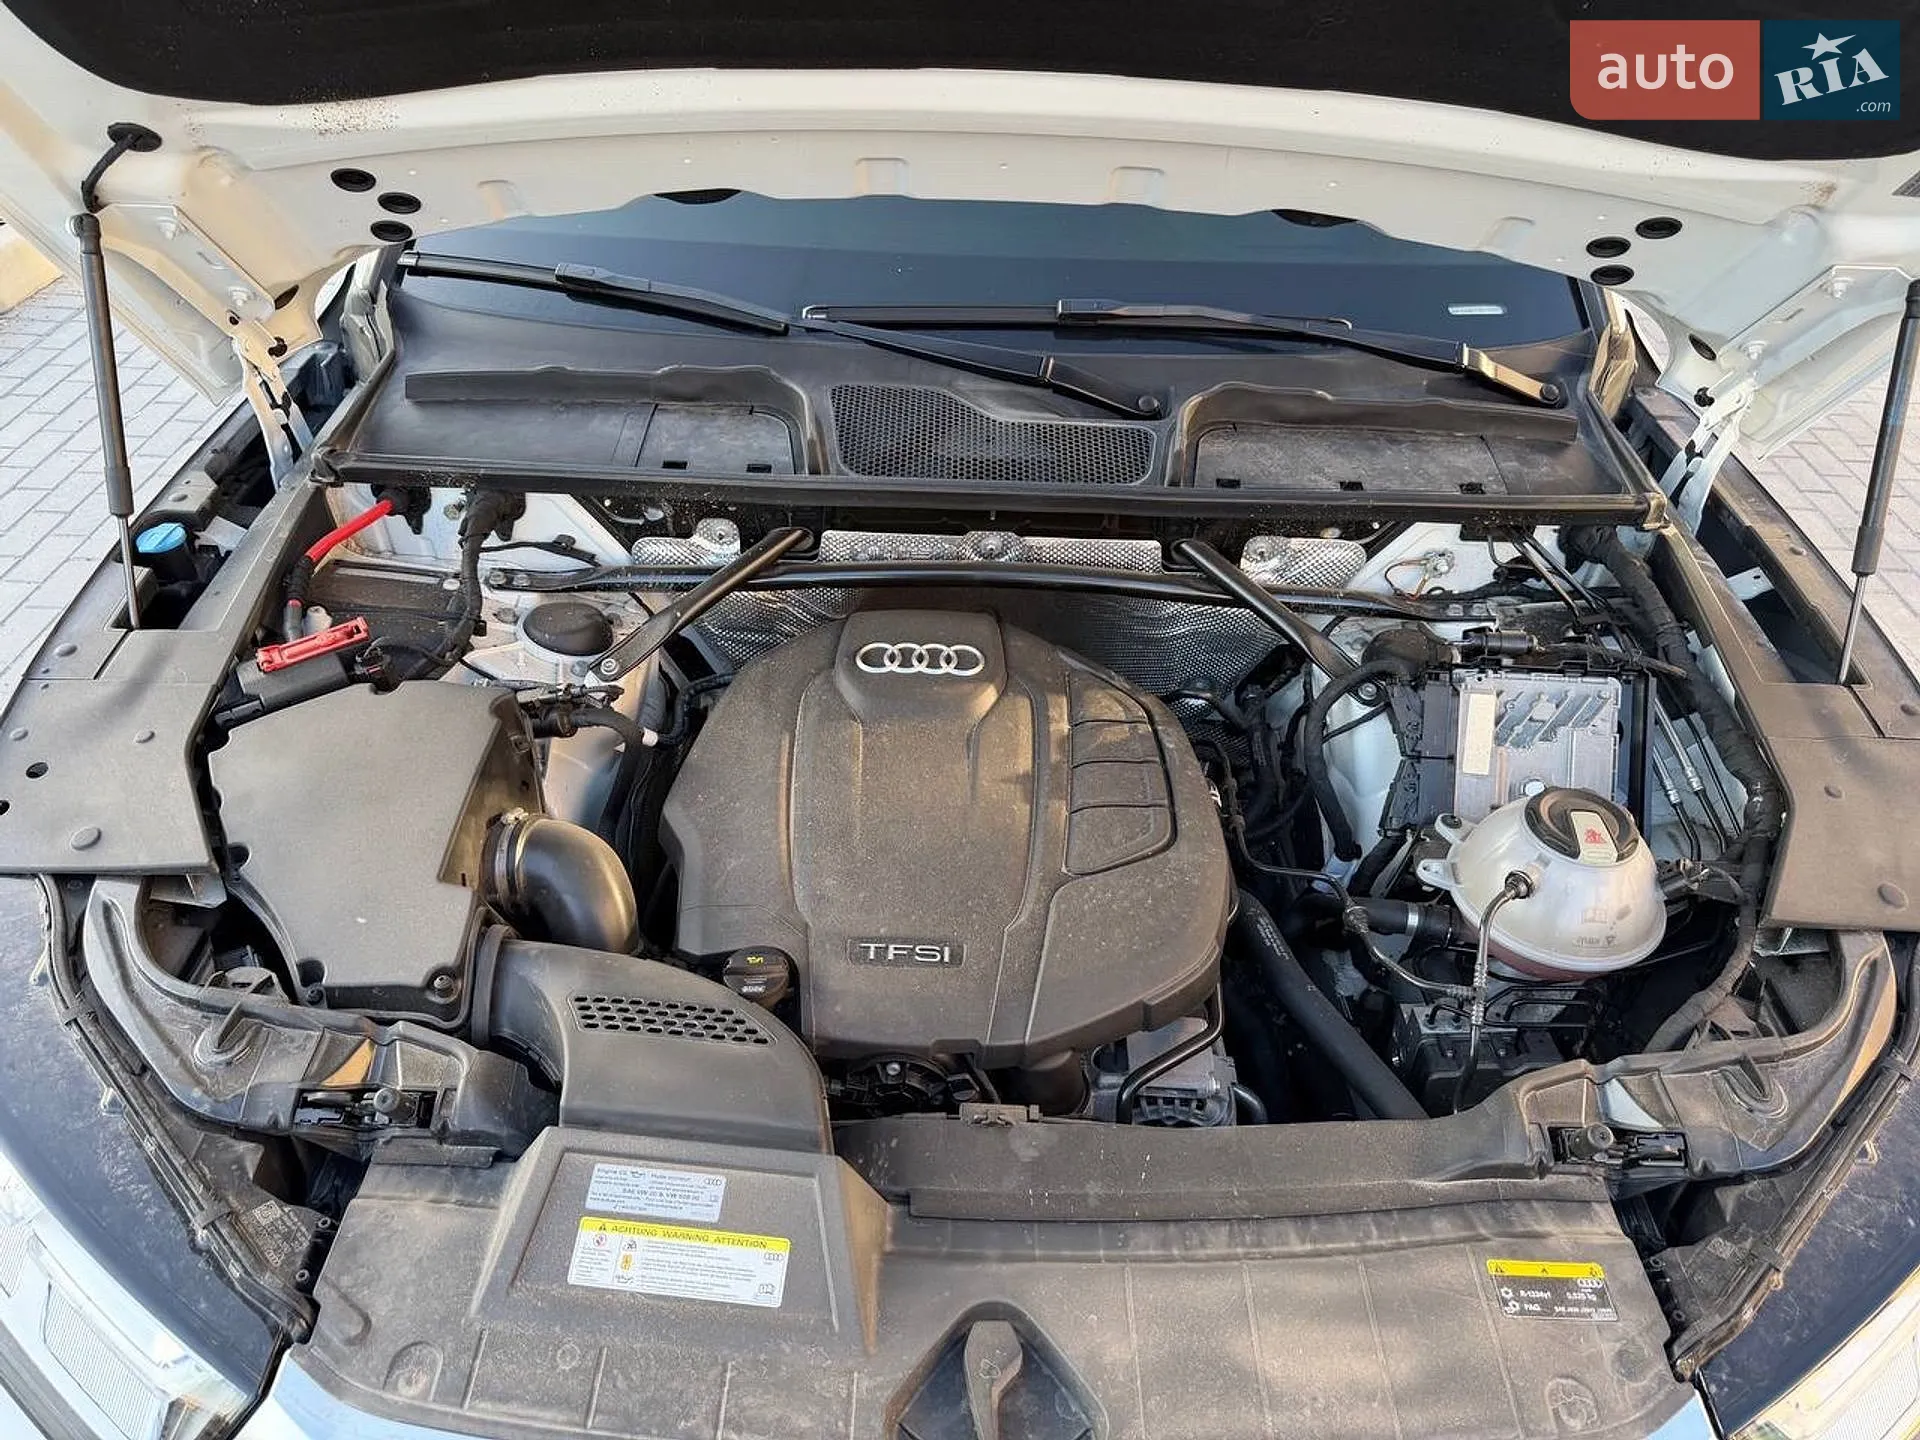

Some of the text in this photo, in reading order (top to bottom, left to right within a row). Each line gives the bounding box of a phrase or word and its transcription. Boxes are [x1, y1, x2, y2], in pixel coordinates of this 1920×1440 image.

[859, 943, 950, 963] TFSI
[611, 1225, 768, 1249] ACHTUNG WARNING ATTENTION
